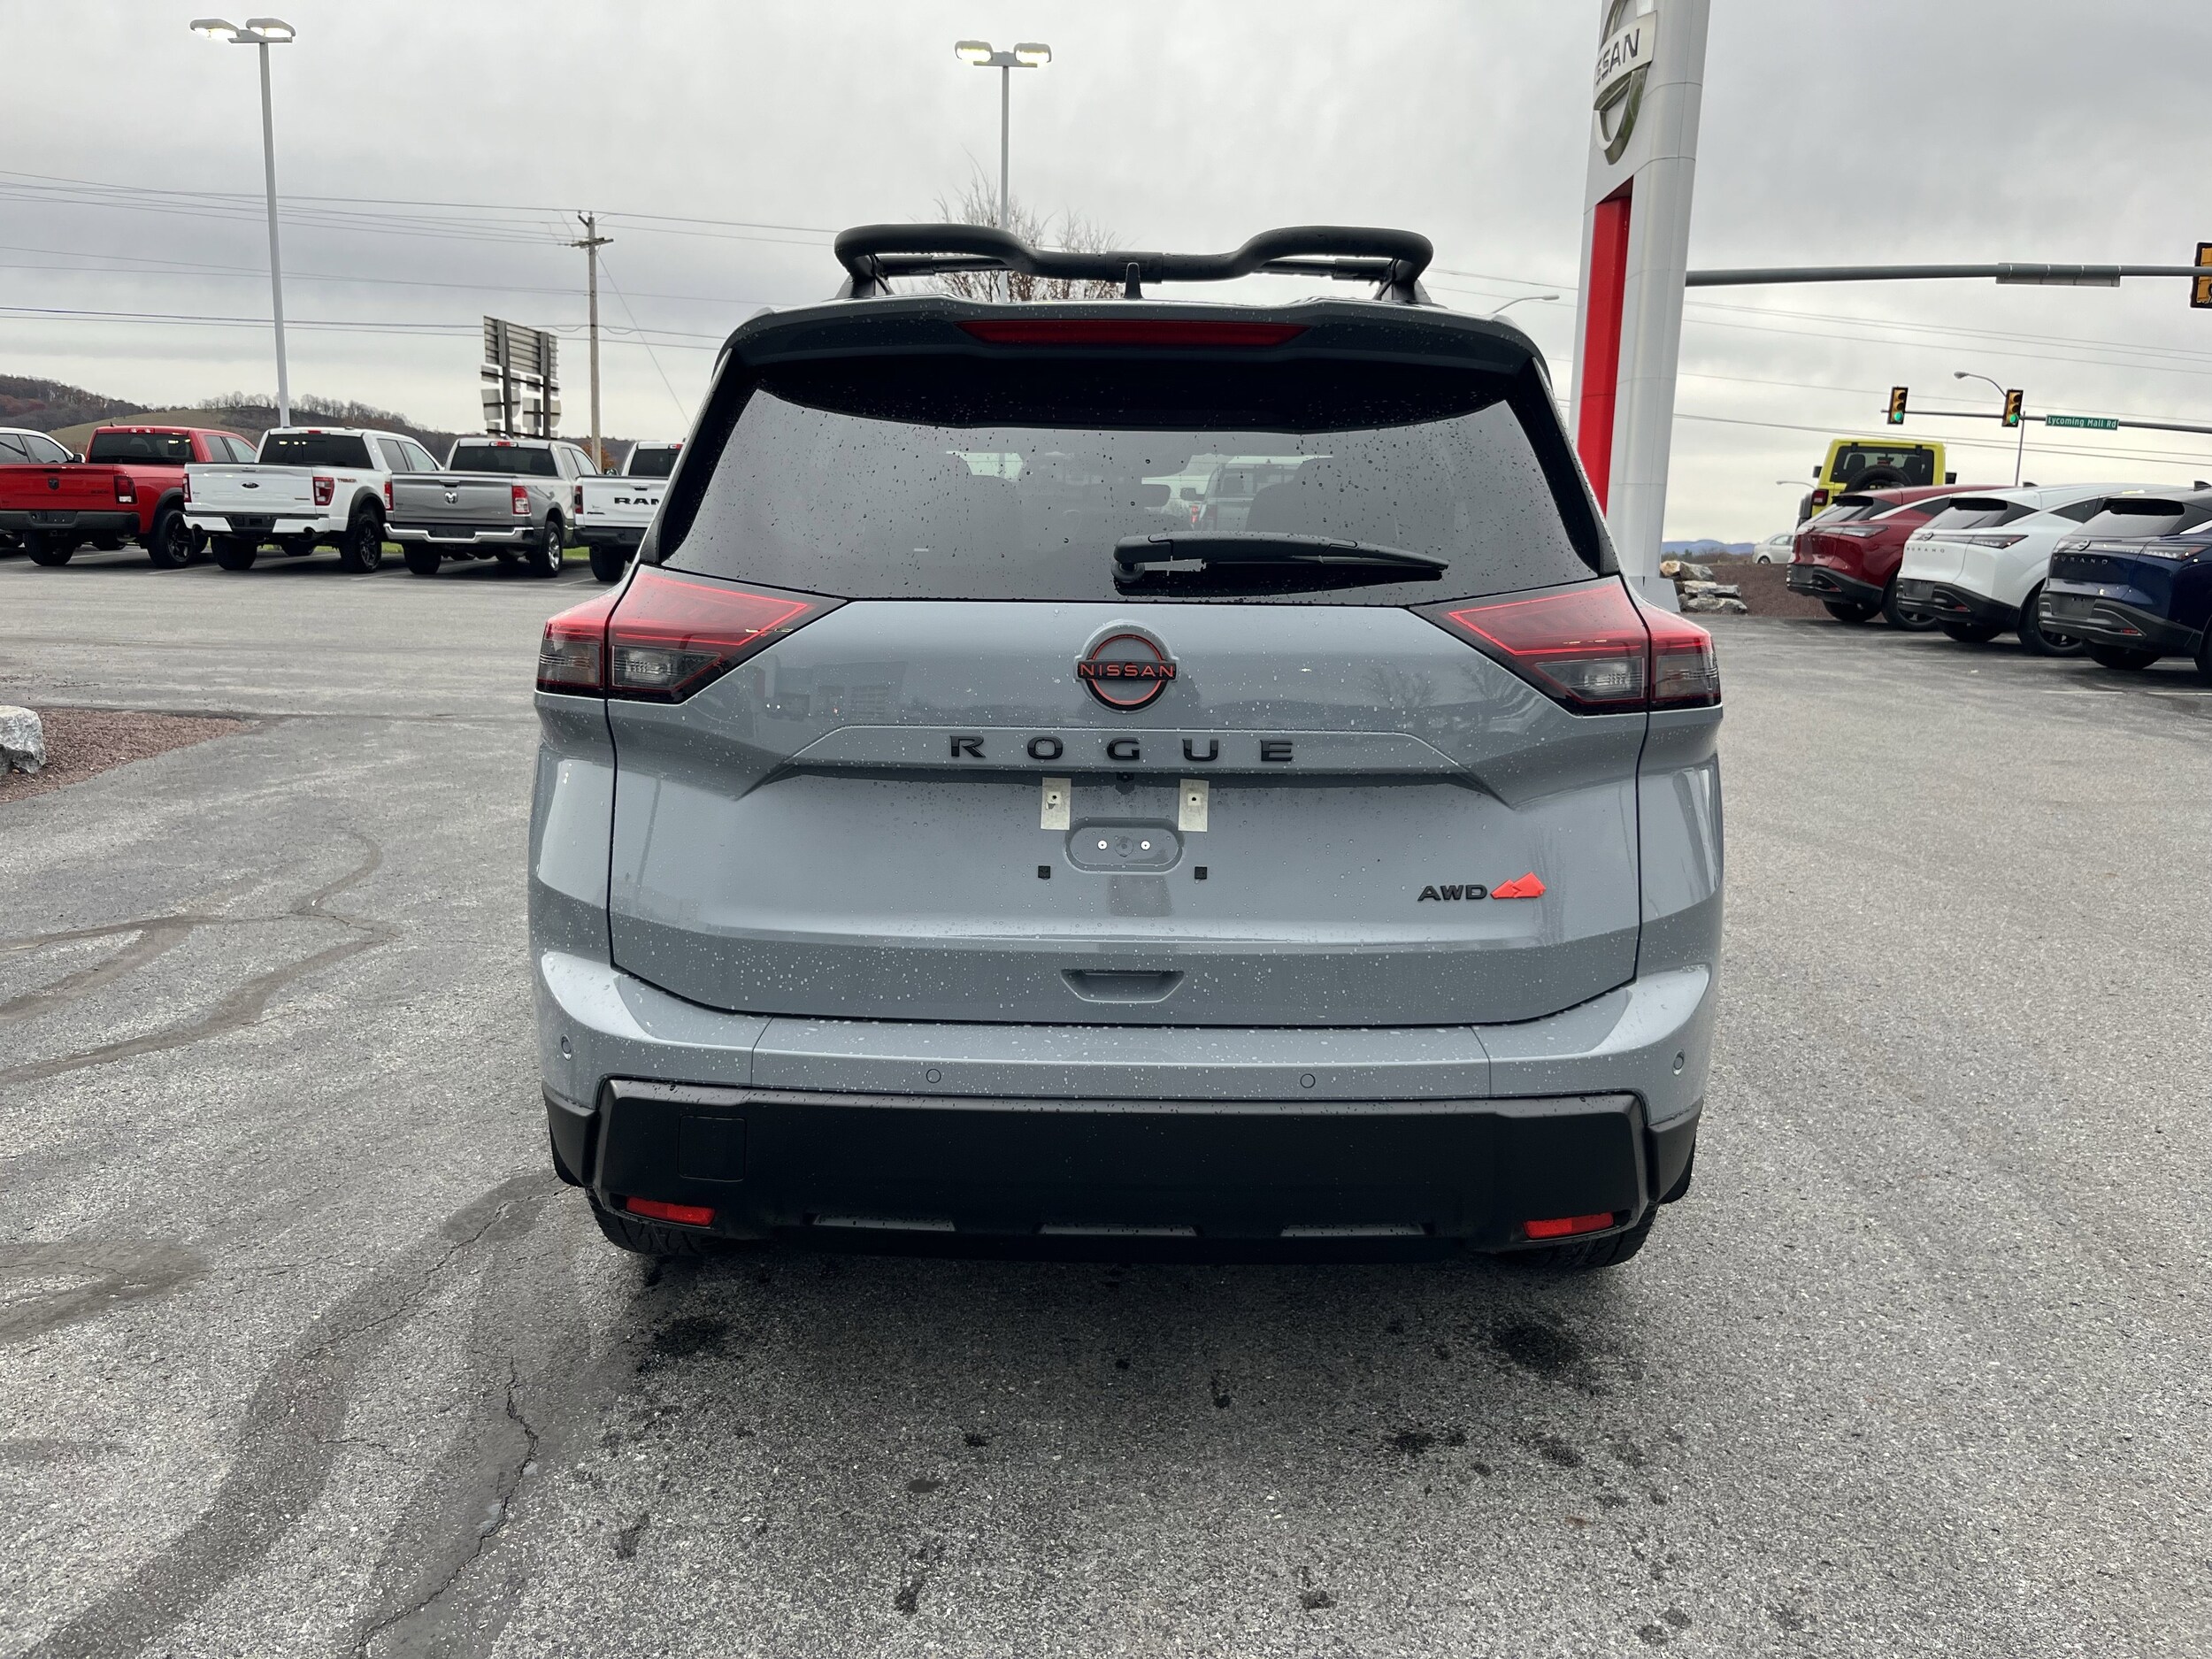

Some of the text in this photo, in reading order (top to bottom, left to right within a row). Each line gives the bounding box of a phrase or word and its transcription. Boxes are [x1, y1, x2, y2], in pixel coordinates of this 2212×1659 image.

[1595, 27, 1640, 87] SSAN
[2047, 416, 2116, 428] Lycoming Mall Rd
[1080, 664, 1174, 677] NISSAN
[949, 735, 1294, 762] ROGUE
[1417, 885, 1488, 901] AWD
